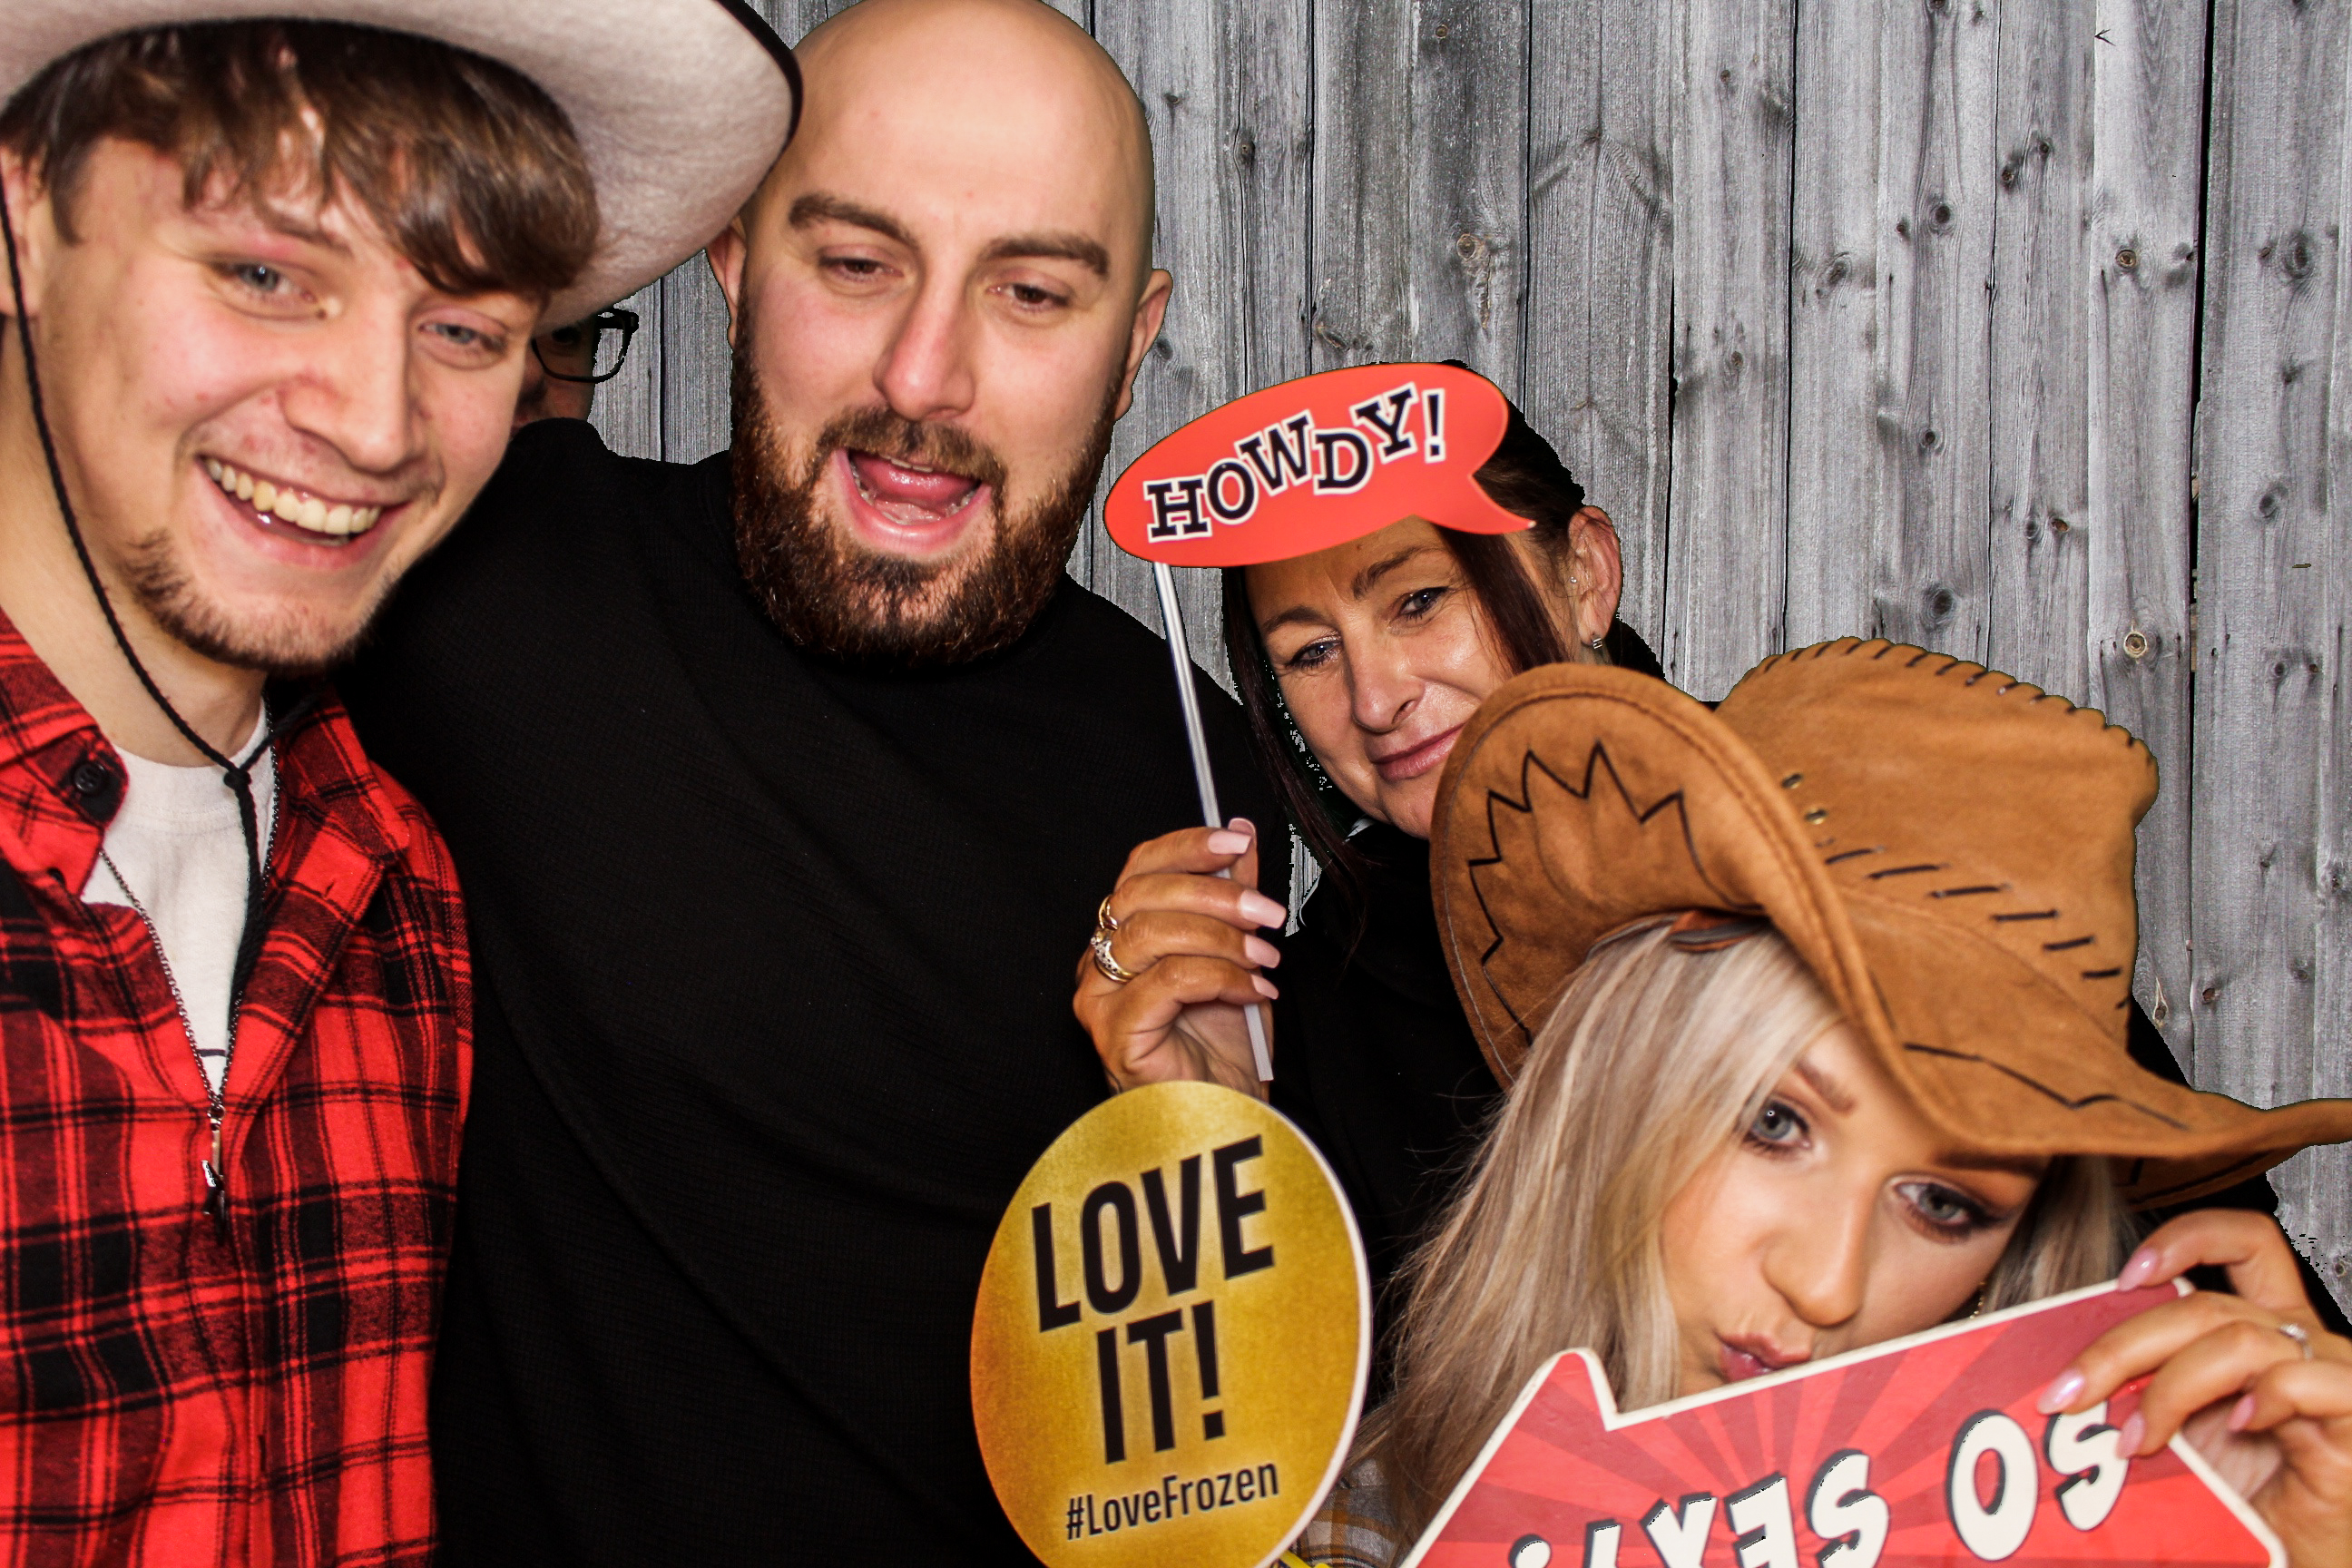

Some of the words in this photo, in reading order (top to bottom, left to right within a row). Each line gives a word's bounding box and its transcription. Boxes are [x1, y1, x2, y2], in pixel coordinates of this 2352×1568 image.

[1144, 382, 1446, 543] HOWDY!
[1032, 1133, 1275, 1333] LOVE
[1096, 1299, 1226, 1465] IT!
[1065, 1462, 1279, 1541] #LoveFrozen
[1945, 1400, 2130, 1562] SO
